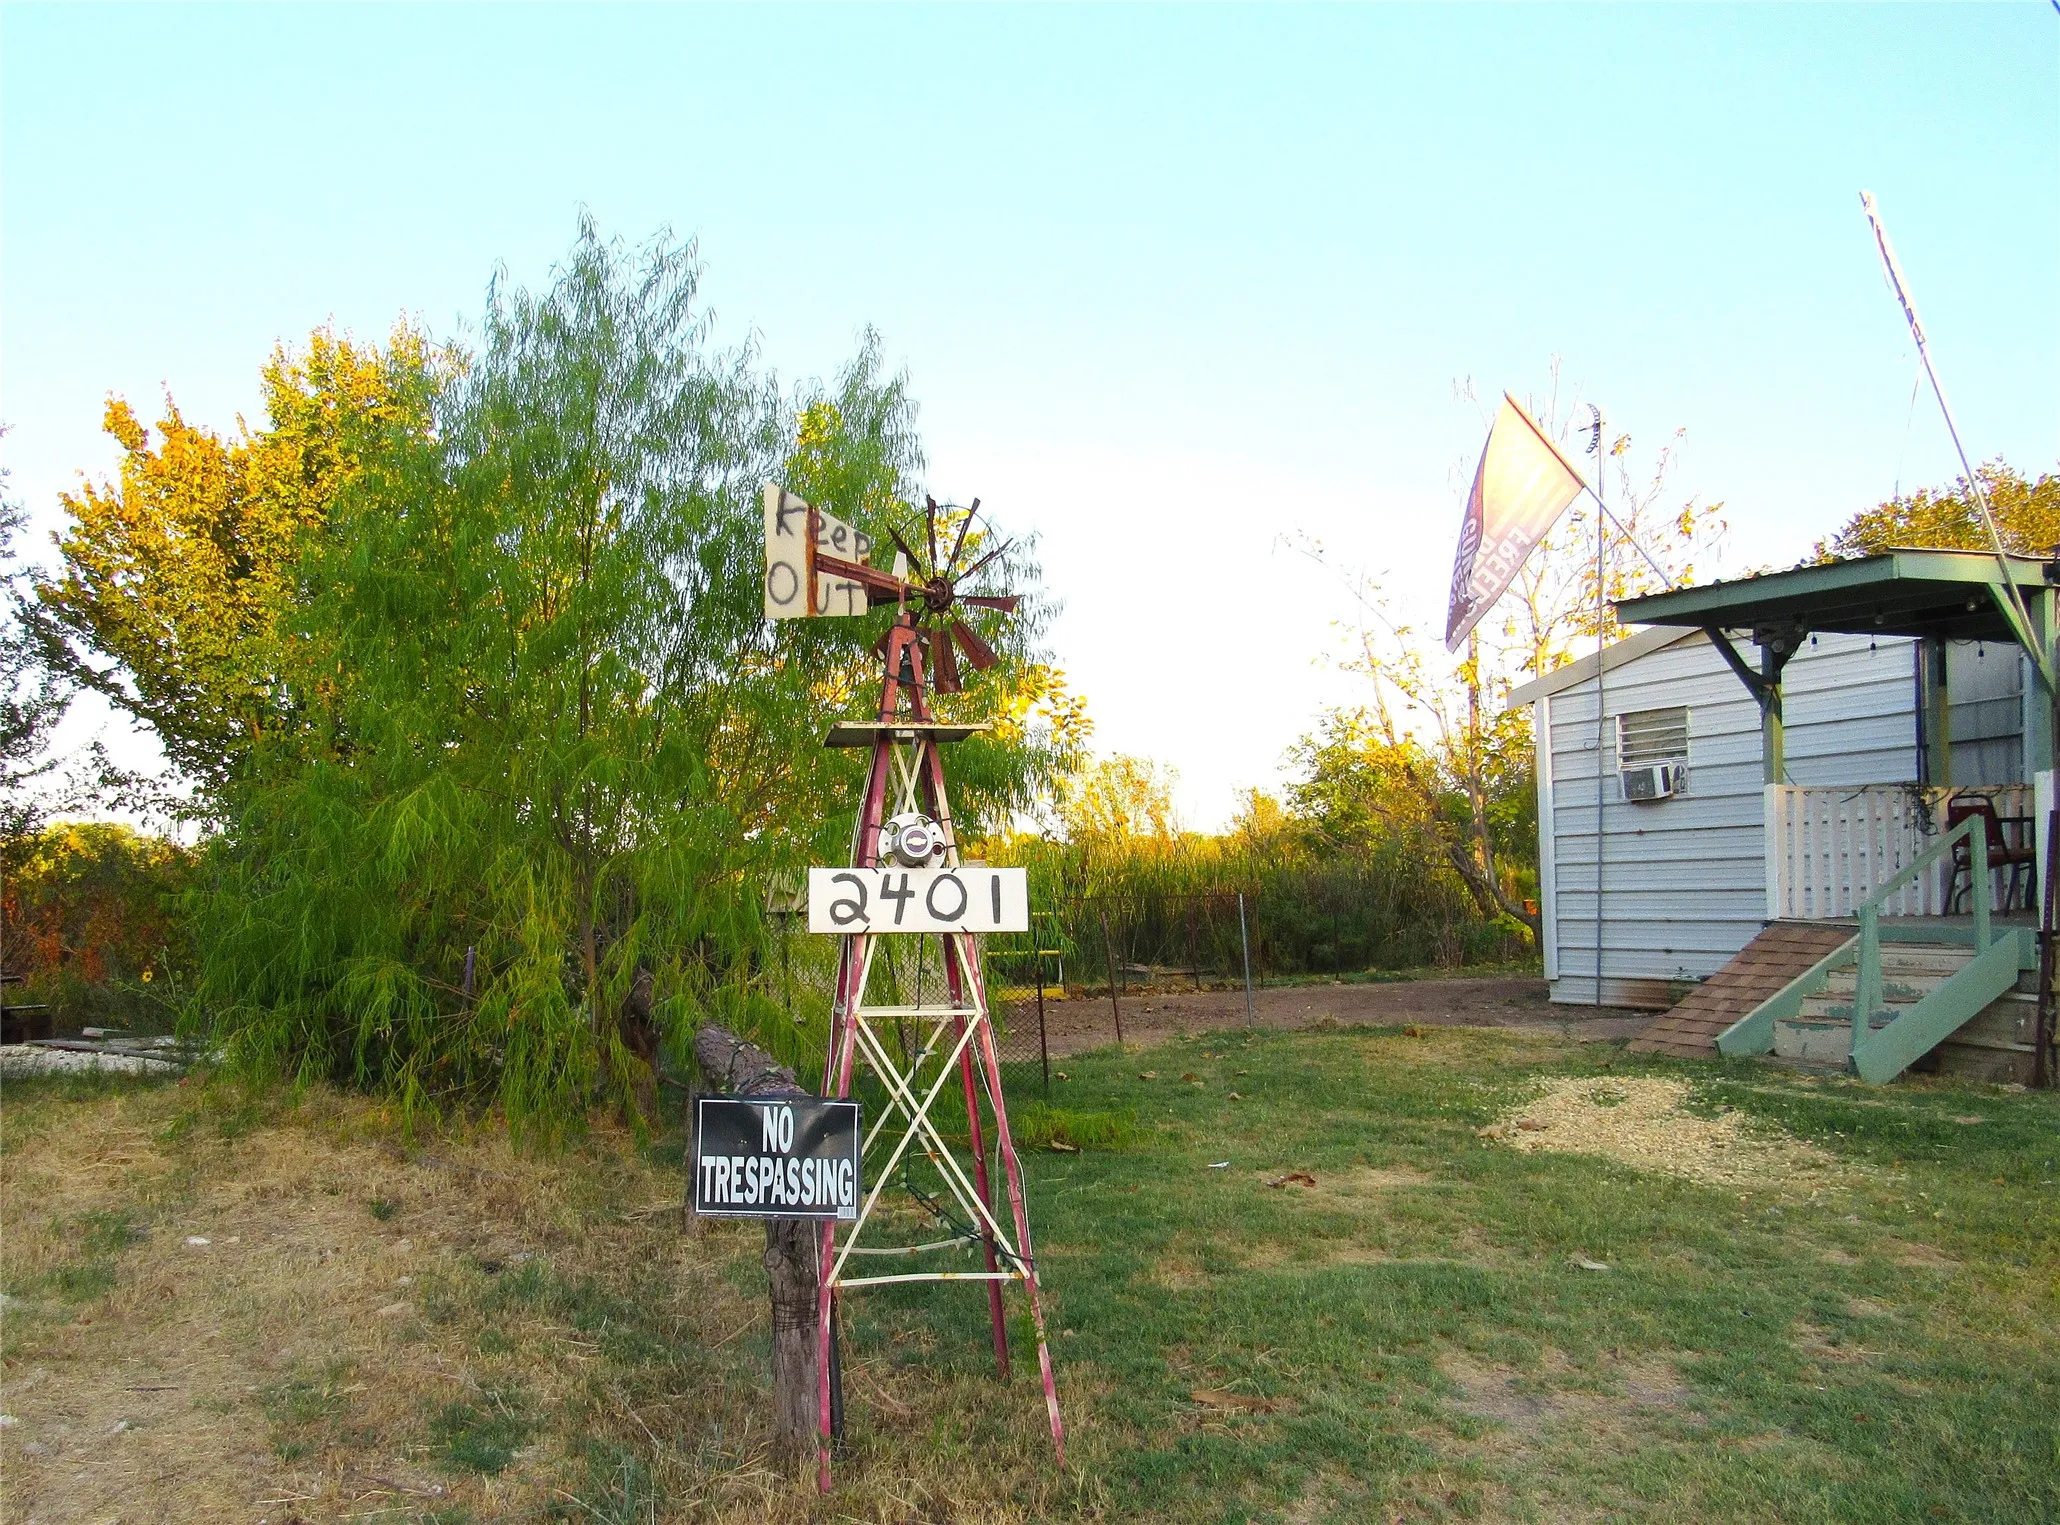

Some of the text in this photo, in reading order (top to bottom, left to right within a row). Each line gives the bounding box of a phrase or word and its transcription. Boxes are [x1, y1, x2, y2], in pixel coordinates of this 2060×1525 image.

[829, 872, 1001, 926] 2401
[762, 1105, 795, 1154] NO
[701, 1155, 853, 1206] TRESPASSING
